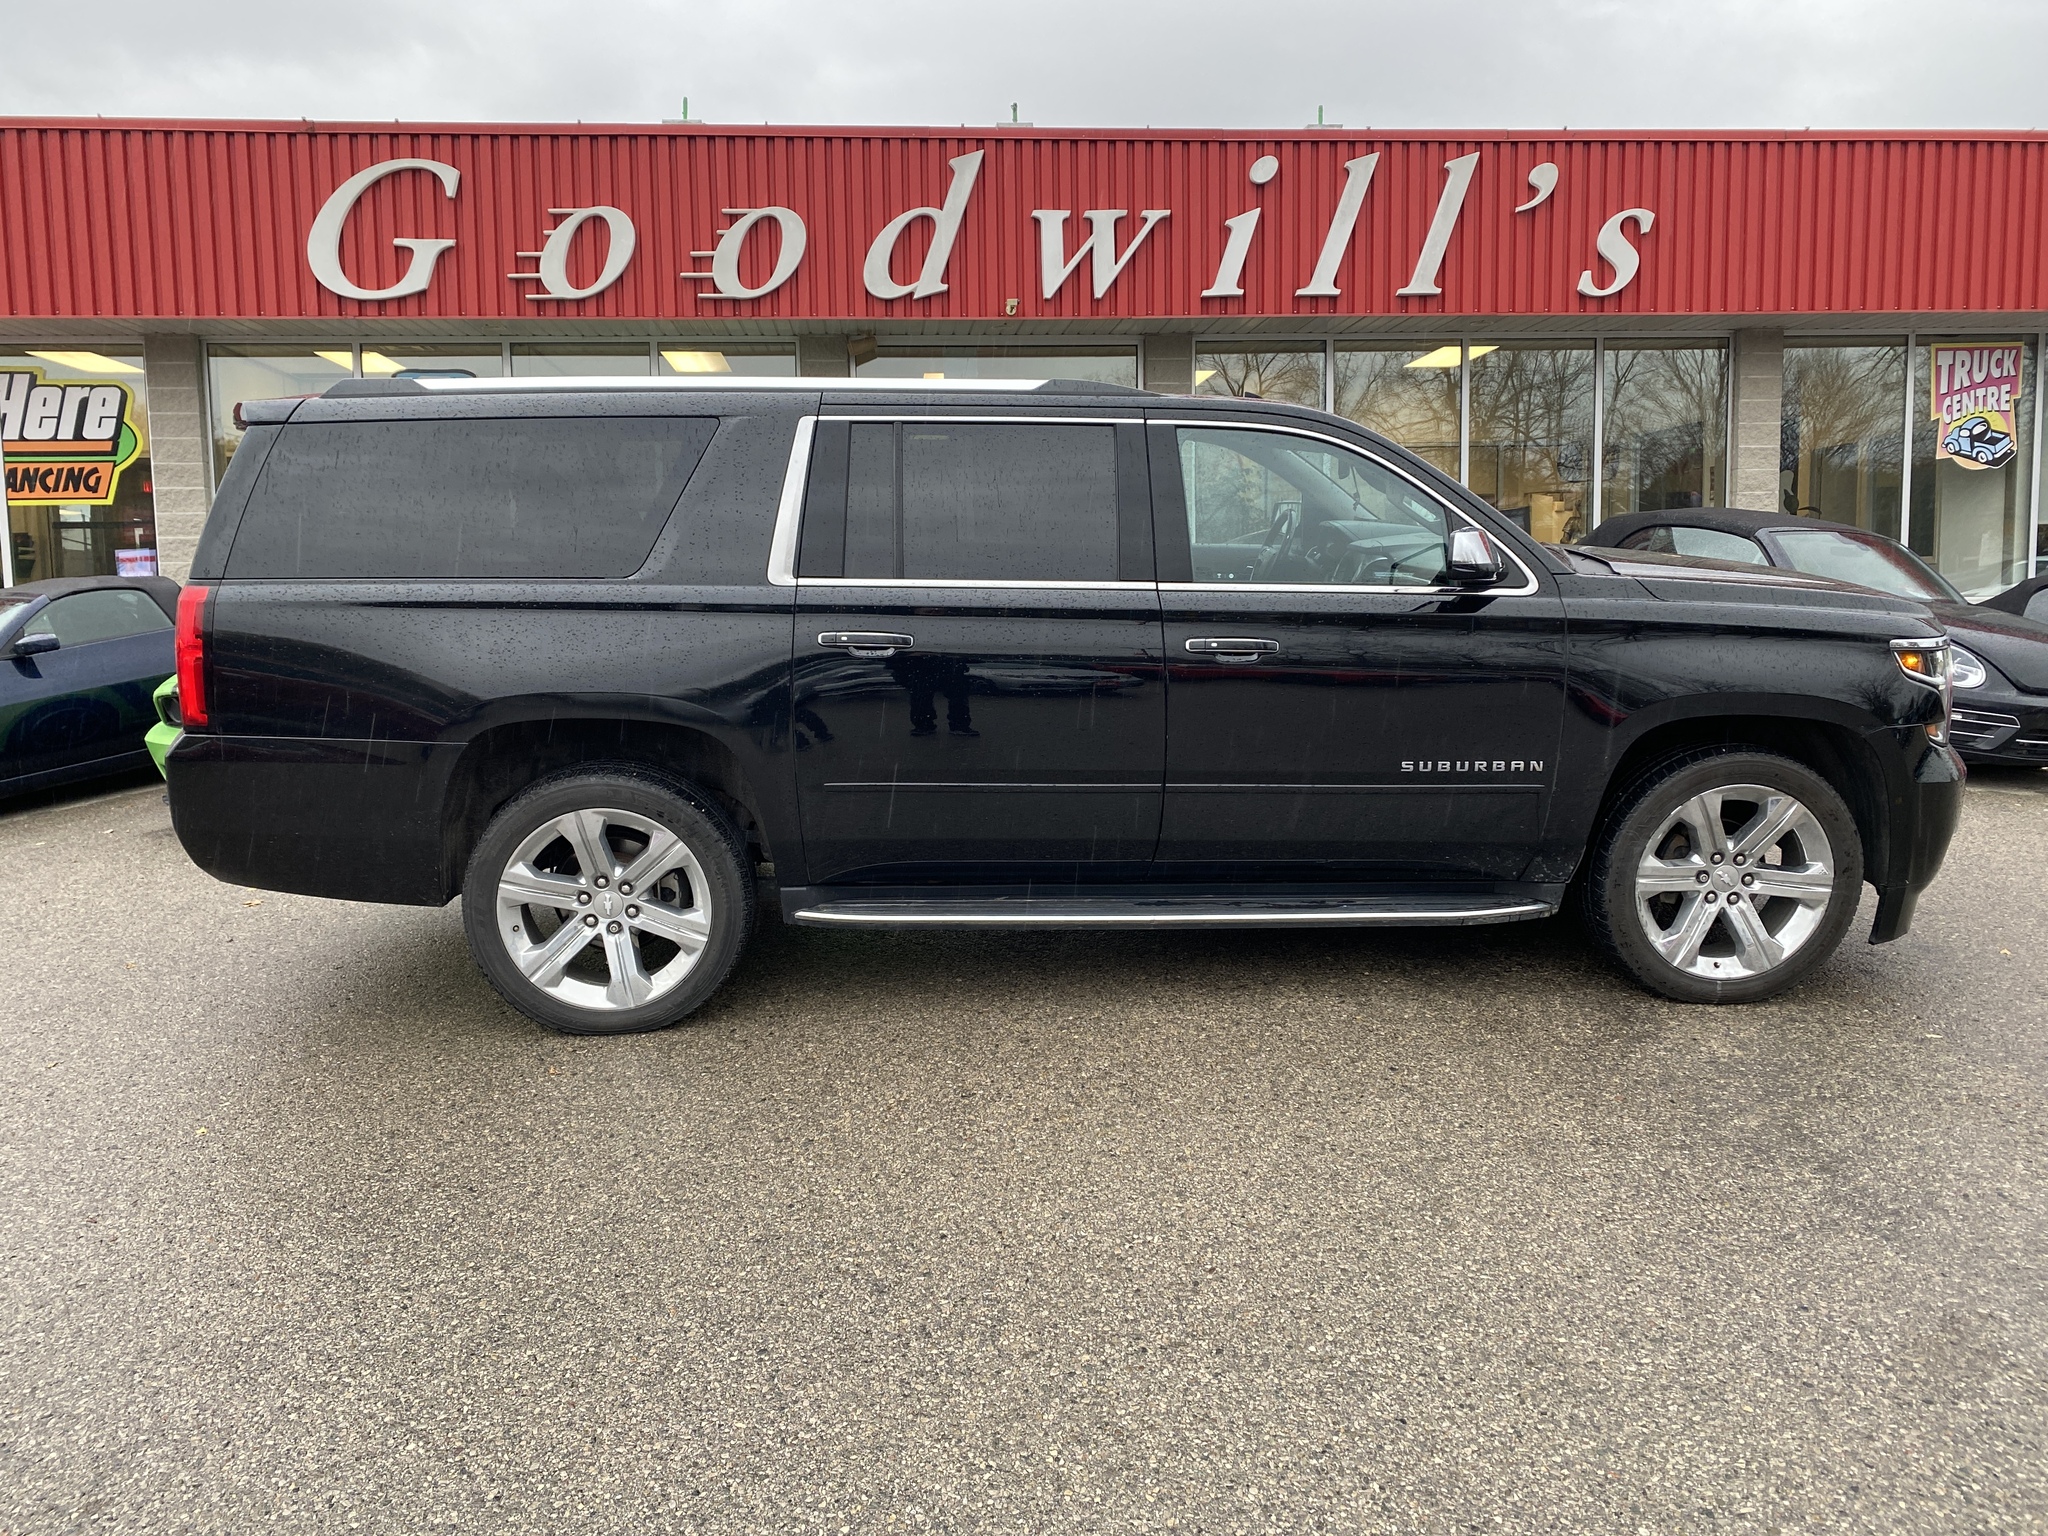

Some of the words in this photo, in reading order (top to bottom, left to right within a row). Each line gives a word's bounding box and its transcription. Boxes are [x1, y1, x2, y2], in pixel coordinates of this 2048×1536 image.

[307, 149, 1656, 300] Goodwill's
[1937, 348, 2018, 395] TRUCK
[0, 373, 121, 440] Here
[1942, 383, 2012, 425] CENTRE
[1400, 760, 1544, 772] SUBURBAN
